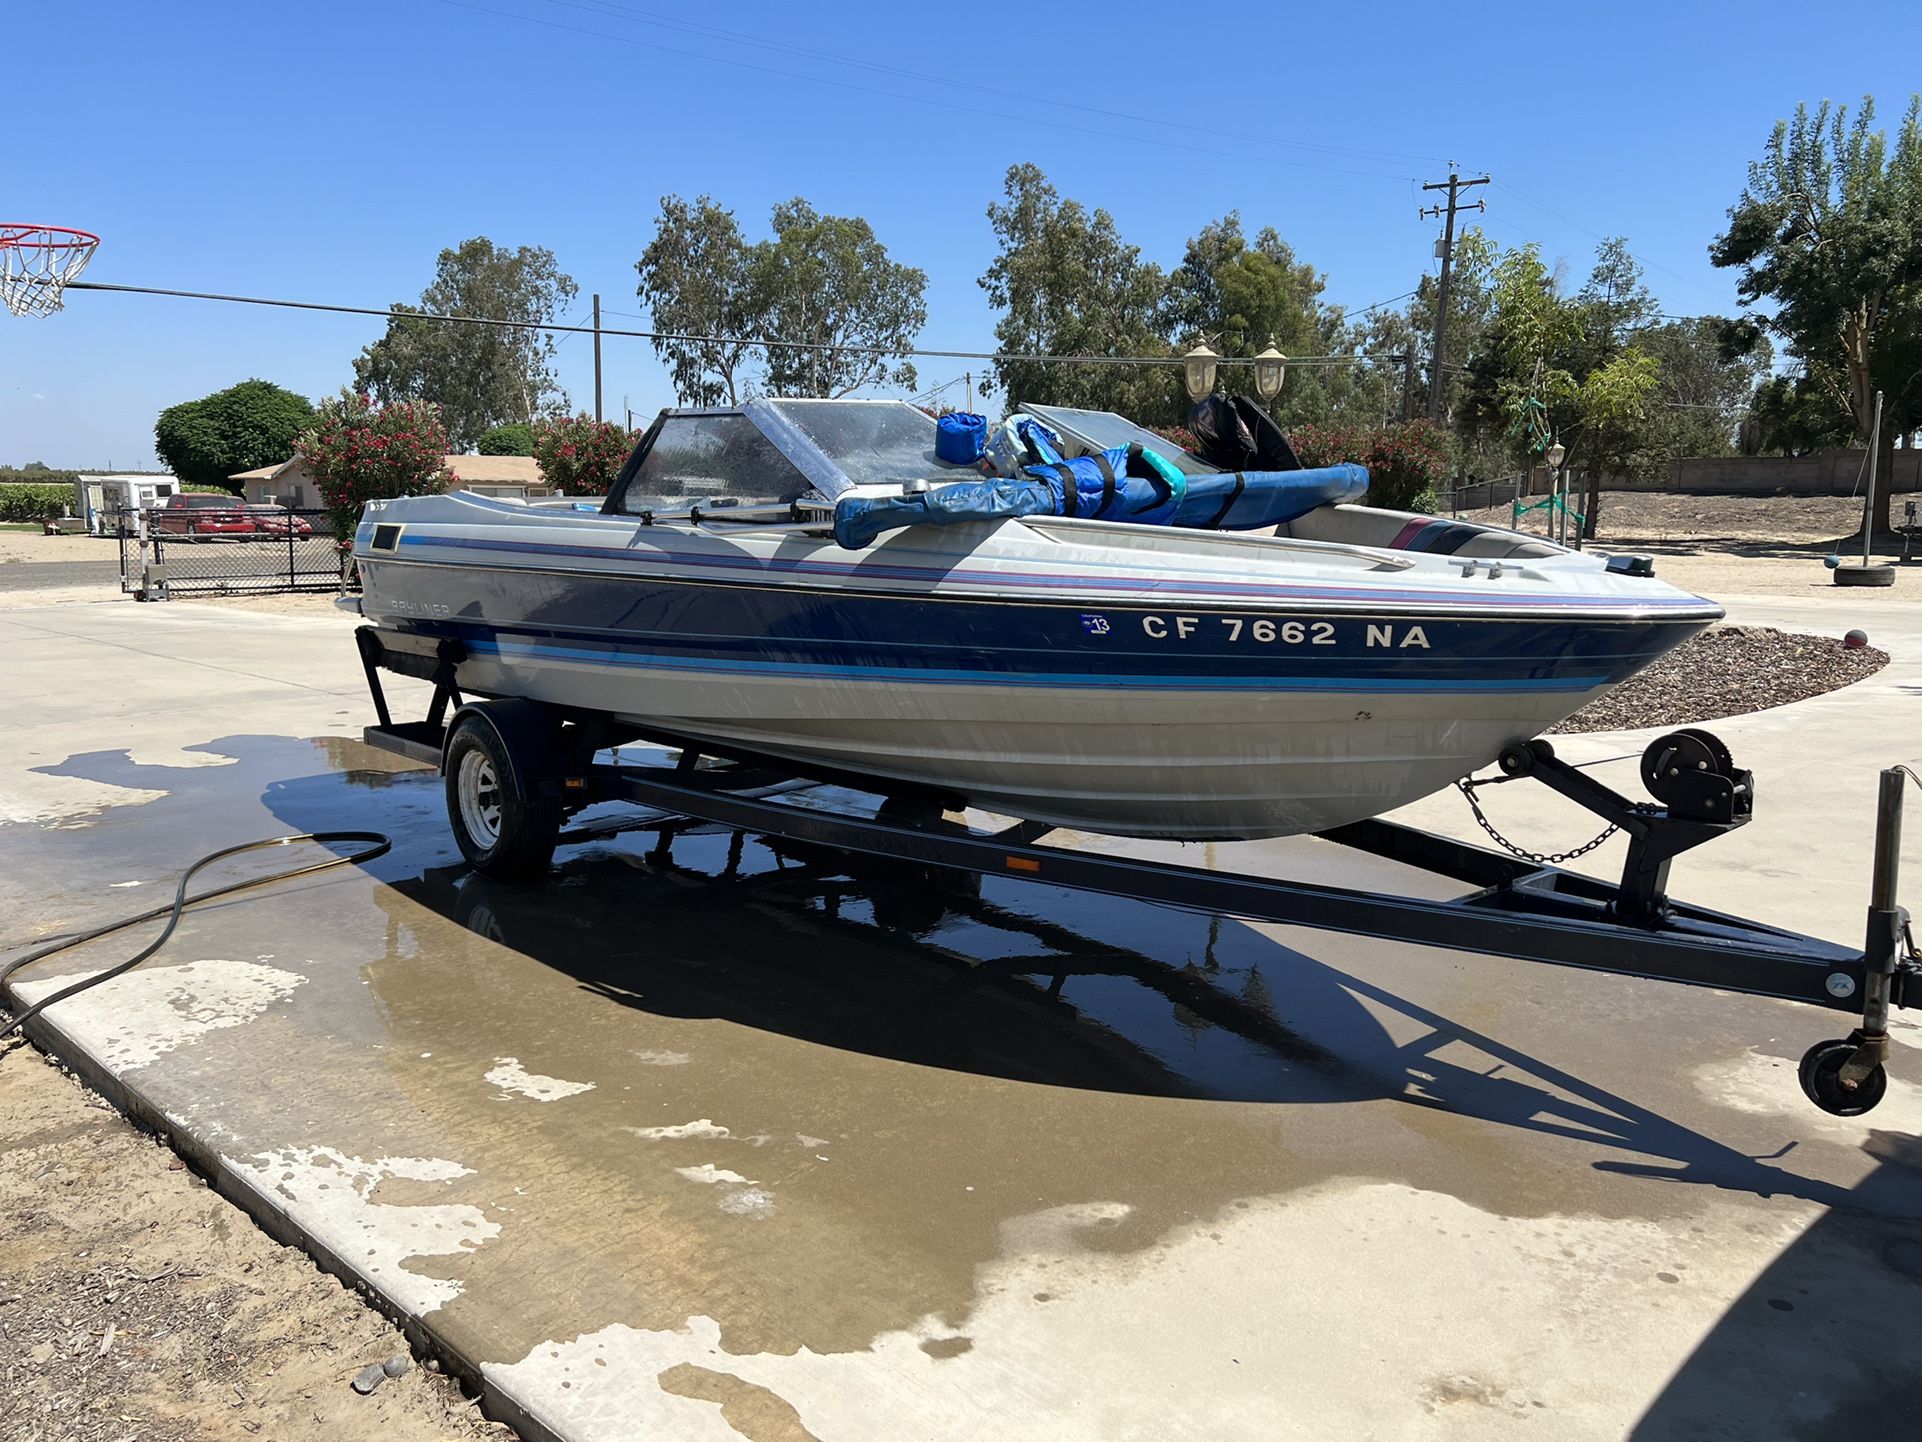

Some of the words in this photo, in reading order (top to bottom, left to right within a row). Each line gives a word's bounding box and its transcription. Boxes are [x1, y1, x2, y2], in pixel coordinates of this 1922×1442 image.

[1092, 617, 1111, 631] 13
[1142, 615, 1199, 639] CF
[1221, 619, 1336, 645] 7662
[1366, 624, 1431, 648] NA
